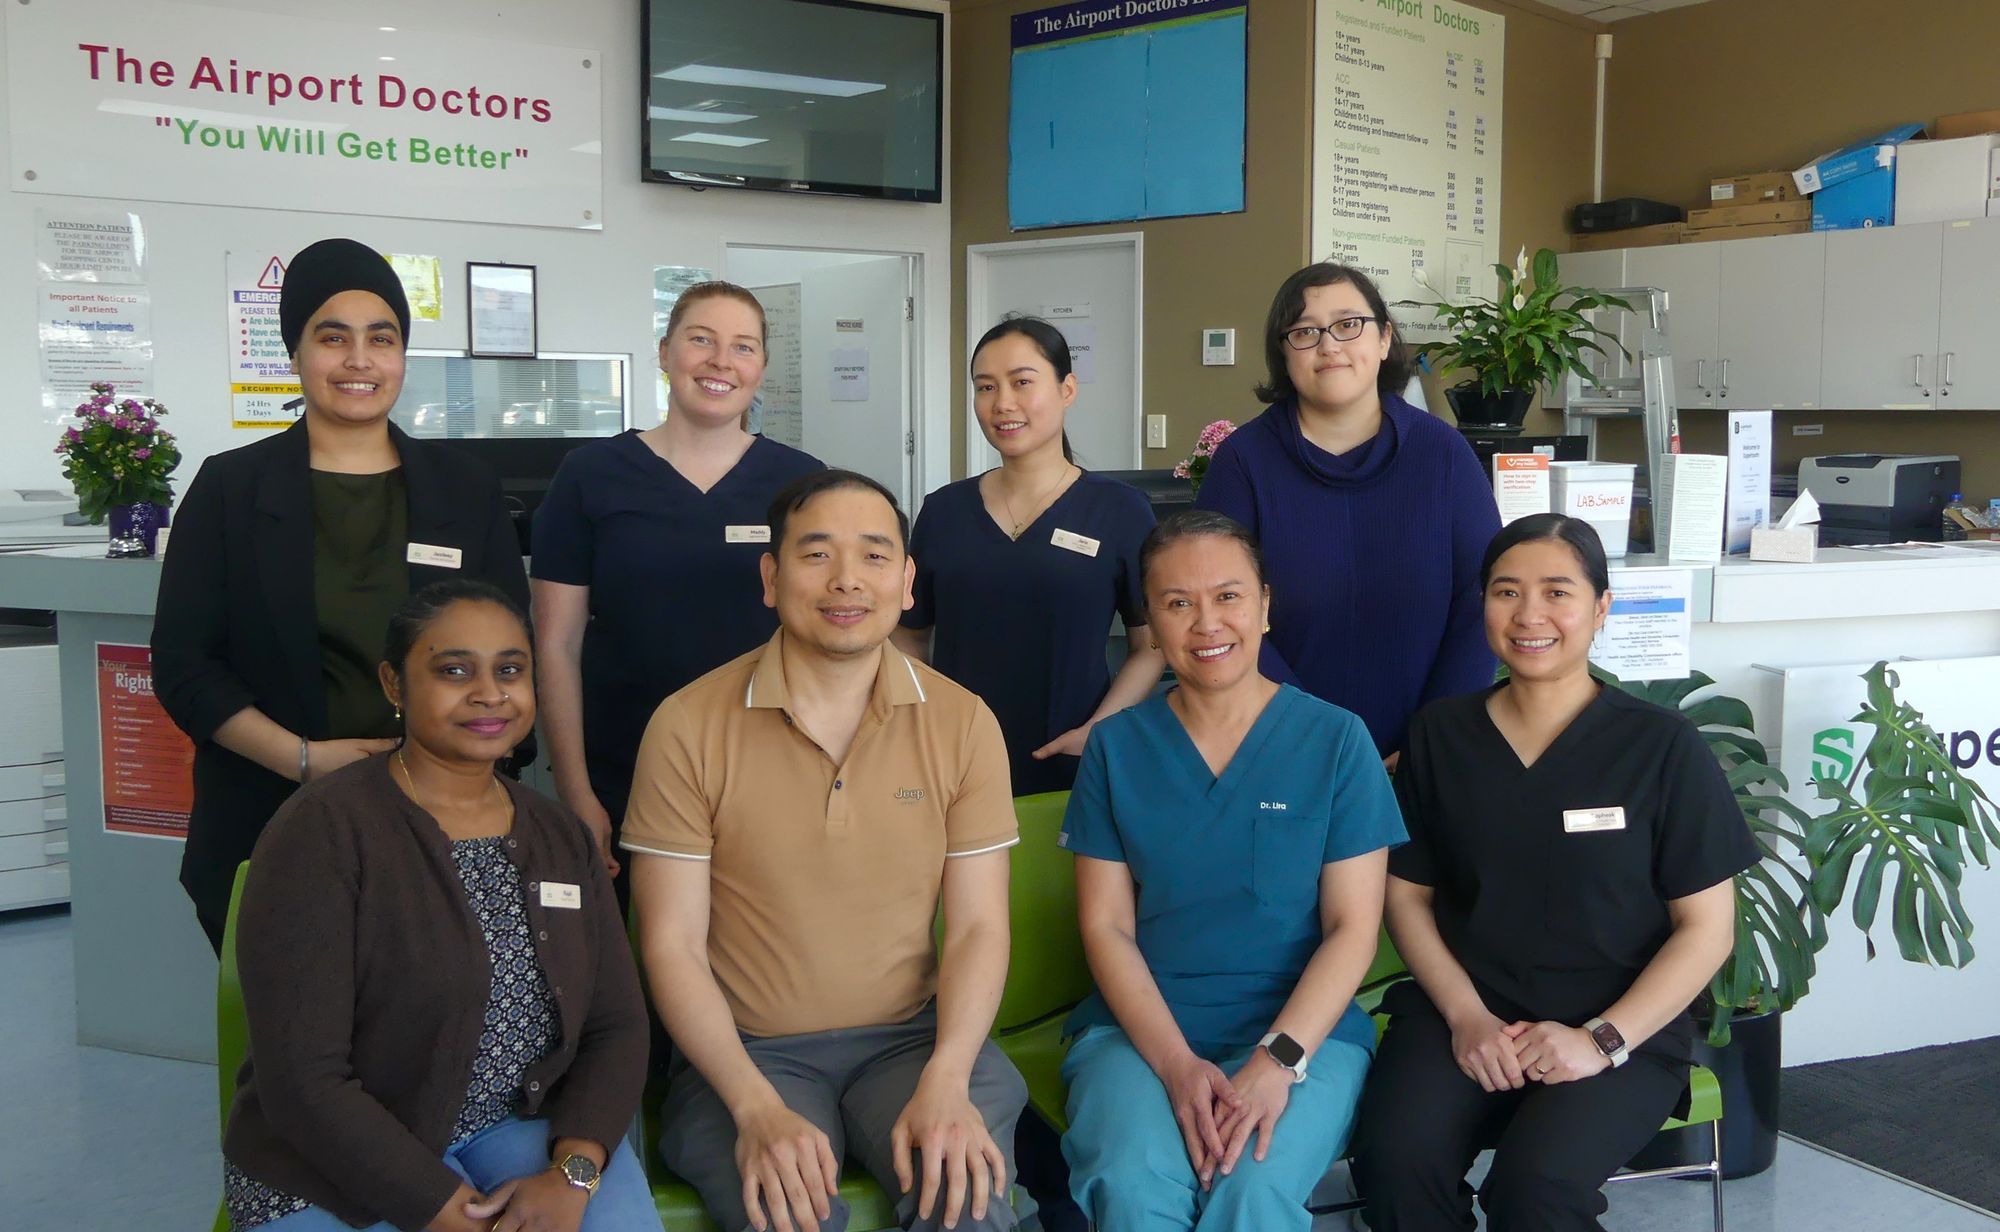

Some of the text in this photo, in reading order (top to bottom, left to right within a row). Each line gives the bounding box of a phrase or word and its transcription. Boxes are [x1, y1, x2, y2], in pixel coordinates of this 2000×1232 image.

[1034, 16, 1062, 34] The
[1064, 7, 1122, 29] Airport
[1433, 5, 1480, 36] Doctors
[1346, 34, 1360, 43] years
[1335, 42, 1365, 56] 14-17 years
[1335, 53, 1357, 65] Children
[1371, 63, 1385, 71] years
[79, 44, 553, 123] The Airport Doctors
[1335, 73, 1350, 84] ACC
[1448, 80, 1457, 89] Free
[1335, 86, 1360, 98] 18+ years
[1475, 87, 1485, 96] Free
[1335, 97, 1364, 110] 14-17 years
[1334, 108, 1357, 119] Children
[1370, 117, 1384, 125] years
[1334, 120, 1346, 129] ACC
[1347, 122, 1370, 135] dressing
[1382, 129, 1405, 140] treatment
[1406, 134, 1421, 142] follow
[1447, 131, 1456, 139] Free
[155, 116, 529, 170] "You Will Get Better"
[1334, 153, 1359, 164] 18+ years
[1334, 164, 1388, 181] 18+ years registering
[1333, 186, 1360, 197] 6-17 years
[1334, 175, 1435, 197] 18+ years registering with another person
[1333, 197, 1388, 213] 6-17 years registering
[1333, 208, 1355, 219] Children
[1356, 211, 1371, 220] under
[48, 221, 95, 229] ATTENTION
[49, 293, 95, 301] Important
[97, 295, 126, 303] Notice
[82, 306, 118, 314] Patients
[240, 307, 265, 315] PLEASE
[249, 317, 262, 325] Are
[1412, 321, 1426, 331] Friday
[250, 328, 268, 336] Have
[251, 339, 263, 347] Are
[250, 349, 259, 357] Or
[261, 349, 279, 357] have
[1577, 494, 1625, 507] LAB SAMPLE
[103, 659, 127, 672] Your
[115, 673, 152, 693] Right
[895, 787, 924, 800] Jeep
[1260, 801, 1271, 809] Dr.
